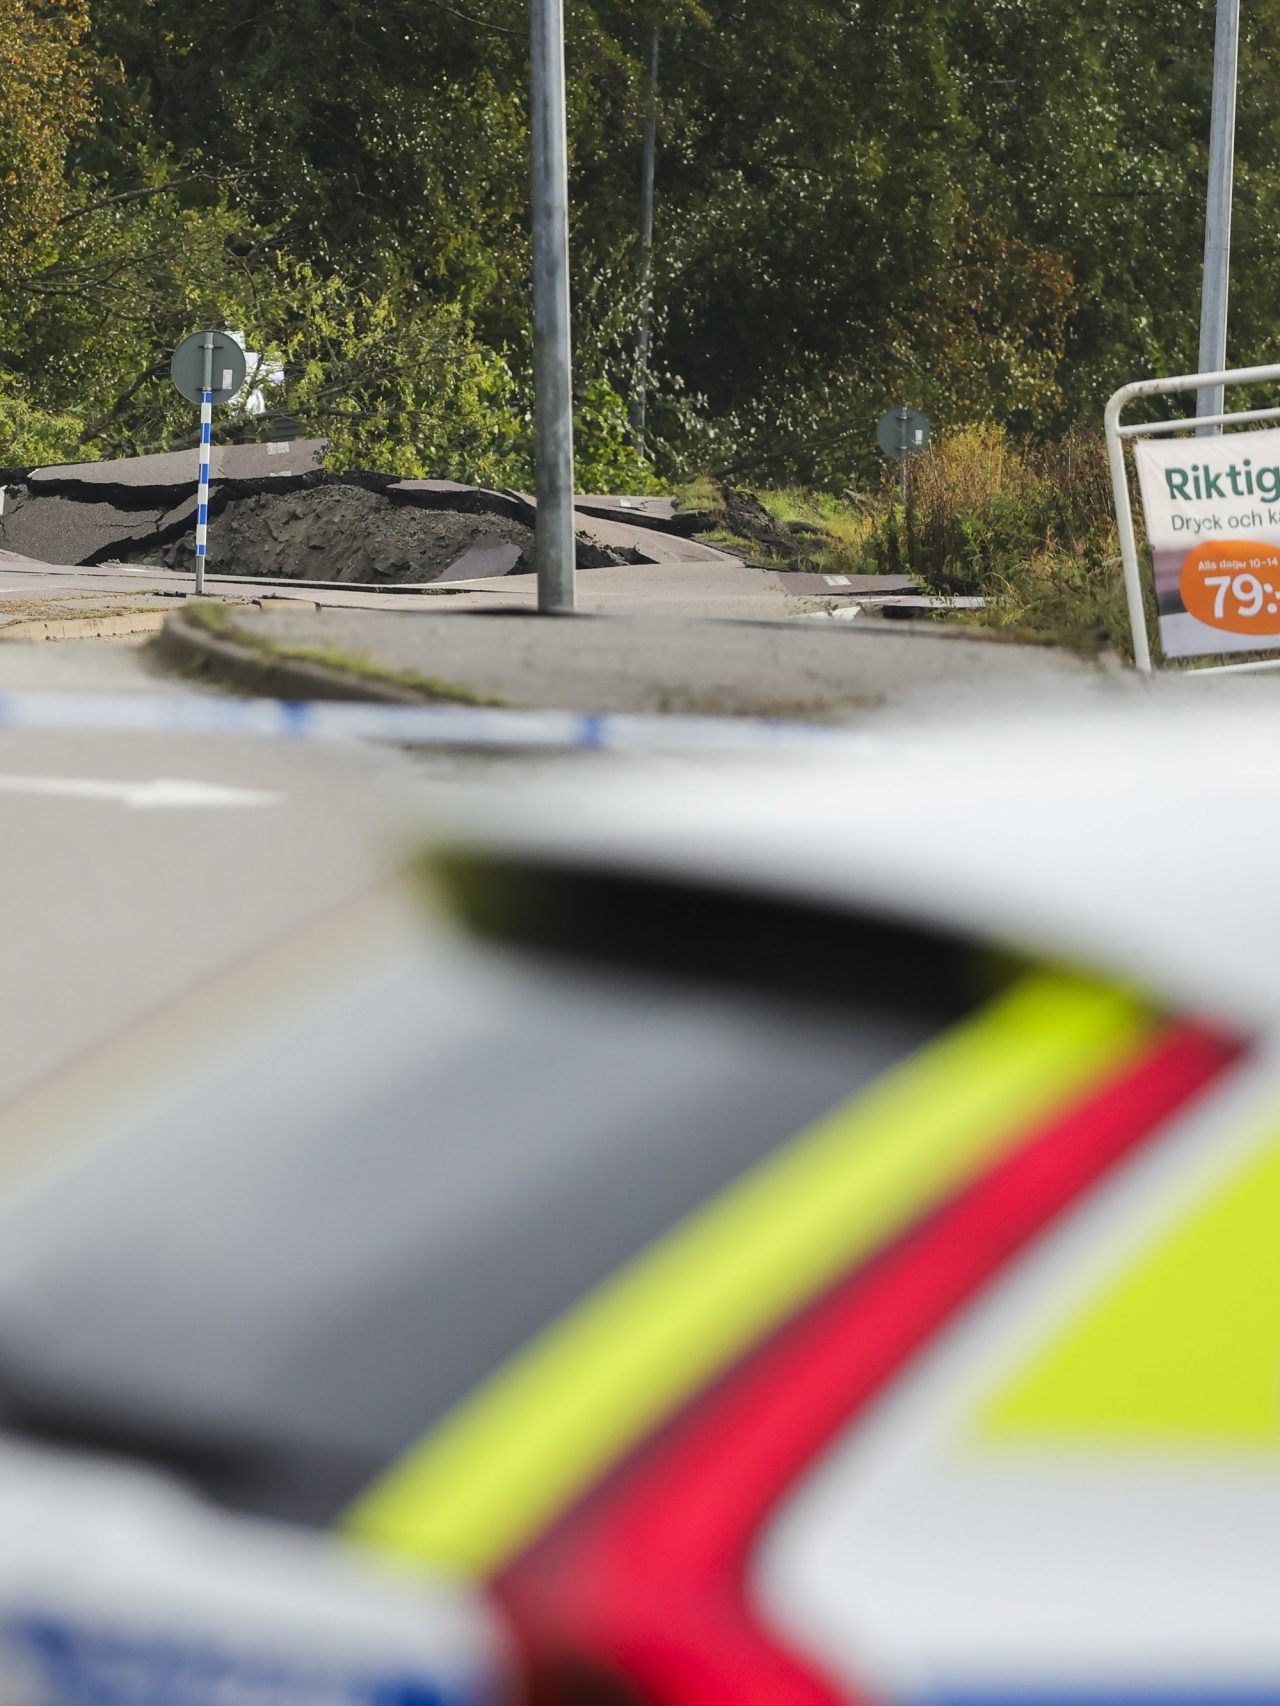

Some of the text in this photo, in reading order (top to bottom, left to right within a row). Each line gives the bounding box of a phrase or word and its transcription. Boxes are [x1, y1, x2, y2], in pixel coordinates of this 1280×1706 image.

[1165, 458, 1280, 503] Riktig
[1171, 507, 1280, 534] Dryck och k
[1198, 559, 1217, 571] Alla
[1249, 556, 1279, 568] 10-14
